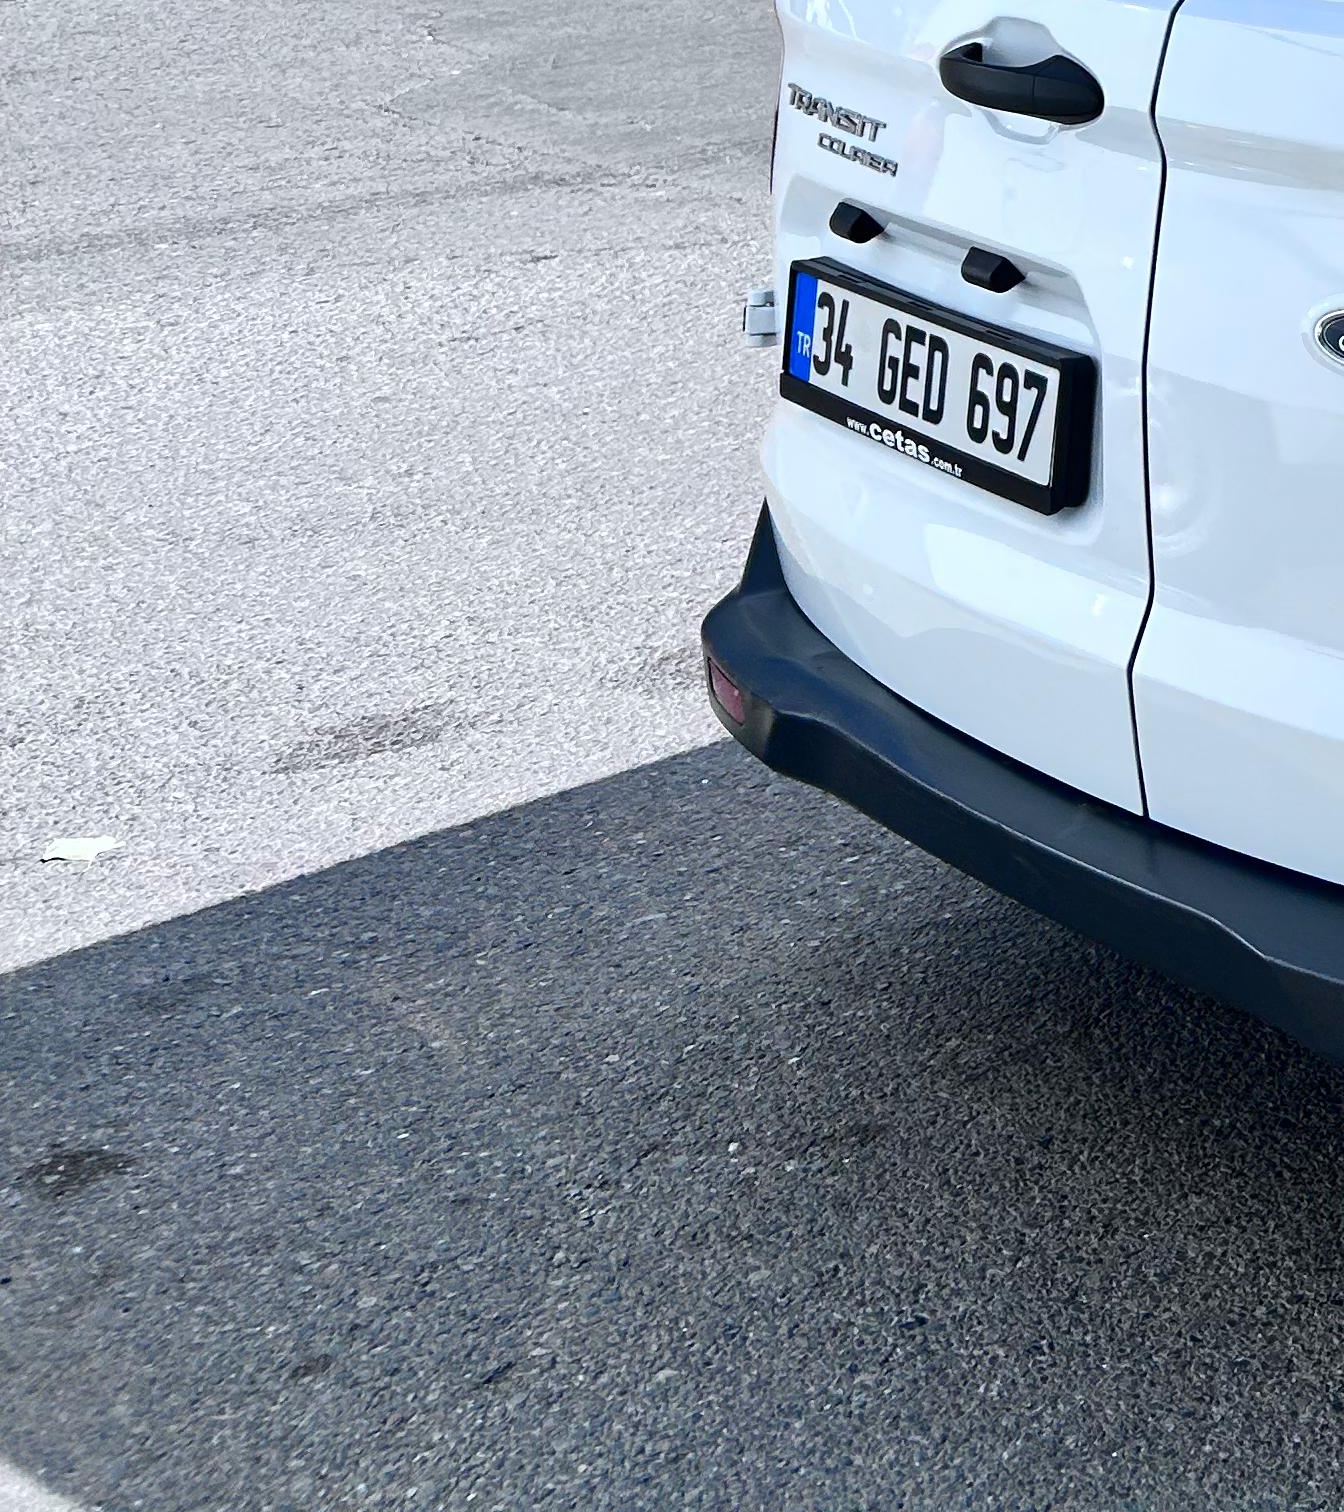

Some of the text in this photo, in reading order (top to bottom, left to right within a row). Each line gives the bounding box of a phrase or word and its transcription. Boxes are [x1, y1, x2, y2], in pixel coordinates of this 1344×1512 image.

[788, 82, 887, 142] TRANSIT
[817, 132, 899, 178] COURIER
[797, 331, 811, 359] TR
[813, 291, 1048, 462] 34 GED 697
